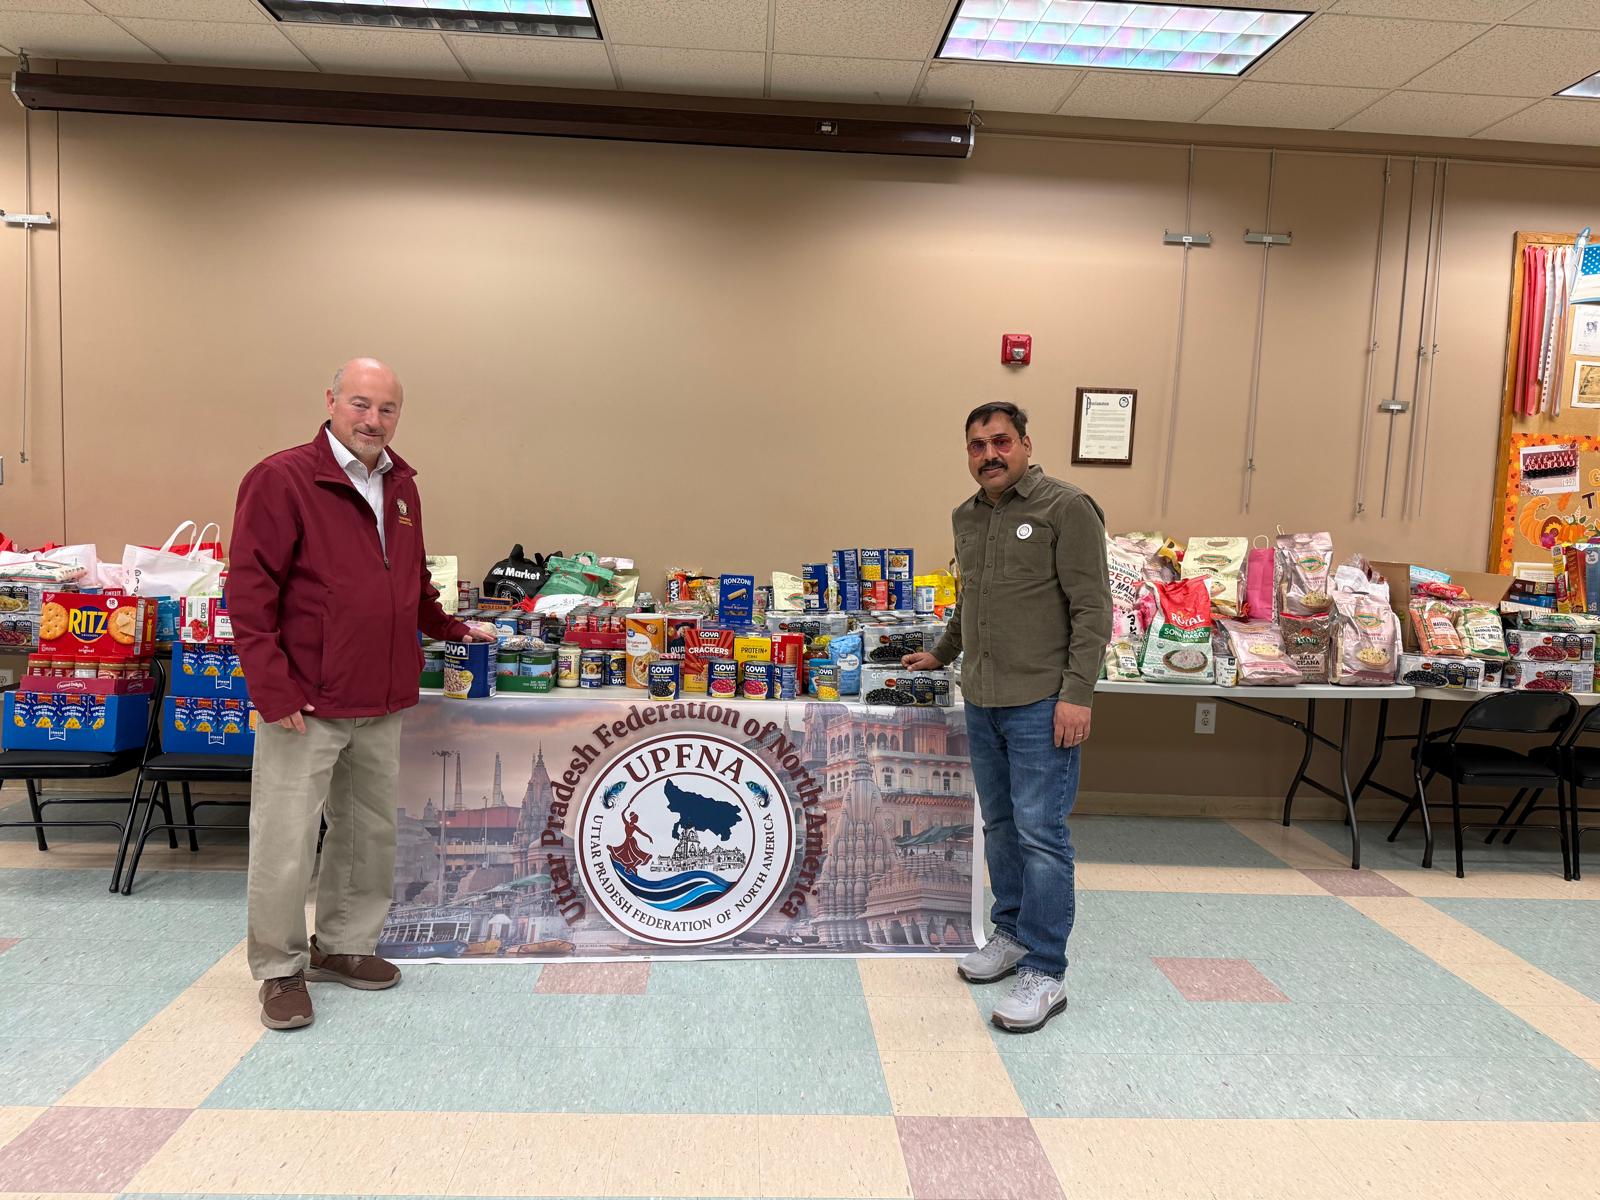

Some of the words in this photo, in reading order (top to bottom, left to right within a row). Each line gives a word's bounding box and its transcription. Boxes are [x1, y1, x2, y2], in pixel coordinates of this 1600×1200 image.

[505, 567, 540, 580] Market
[68, 608, 108, 634] RITZ
[446, 644, 466, 656] OYA
[688, 647, 728, 656] CRACKERS
[592, 701, 741, 748] Federation
[743, 717, 778, 743] of
[622, 743, 745, 784] UPFNA
[766, 733, 824, 809] North
[541, 742, 601, 848] Pradesh
[591, 814, 604, 860] UTTAR
[763, 812, 776, 871] AMERICA
[779, 810, 828, 919] America
[549, 853, 586, 927] Uttar
[593, 861, 632, 914] PRADESH
[737, 870, 768, 913] NORTH
[631, 908, 713, 933] FEDERATION
[716, 908, 733, 925] OF
